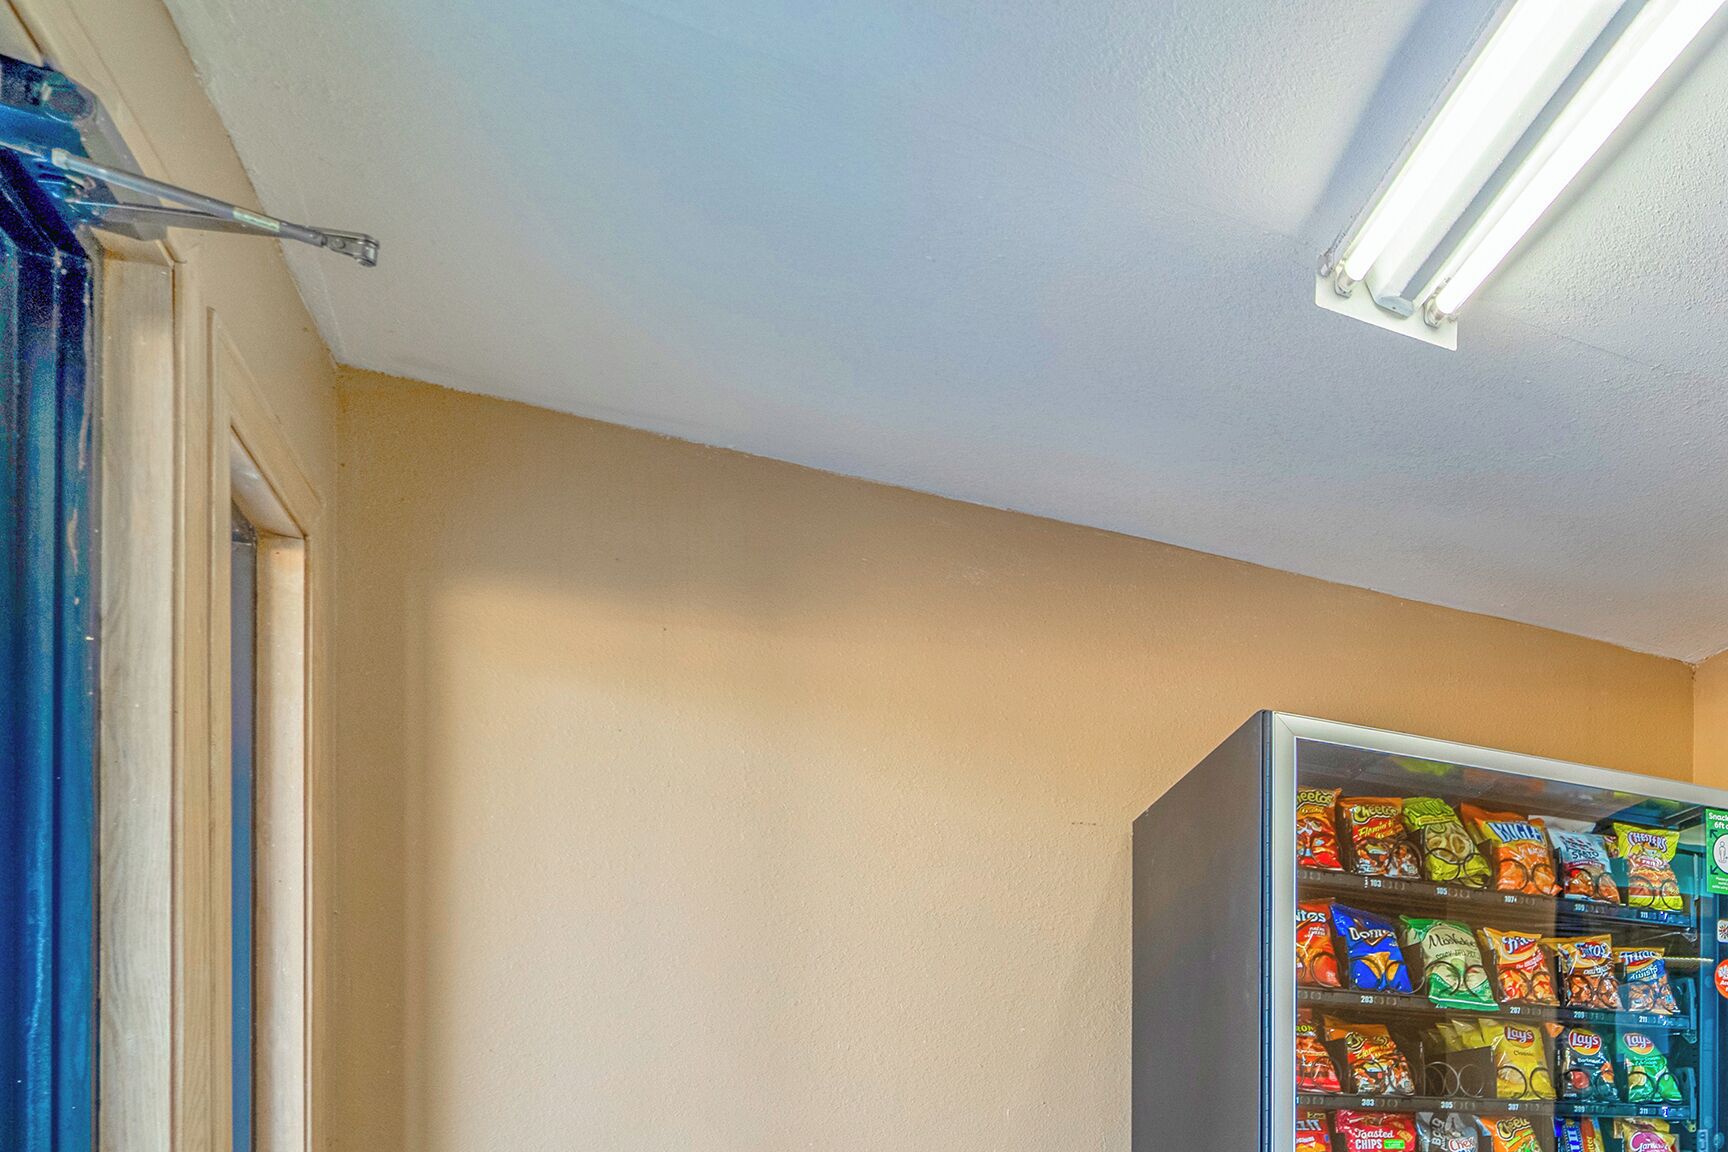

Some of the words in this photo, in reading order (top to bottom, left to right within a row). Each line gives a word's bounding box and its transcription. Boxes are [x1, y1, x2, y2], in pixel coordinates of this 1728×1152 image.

[1708, 812, 1728, 823] Snack
[1714, 821, 1725, 830] 6ft
[1507, 1028, 1533, 1043] Lay's
[1572, 1032, 1600, 1049] Lay's
[1354, 1127, 1395, 1139] Toasted
[1355, 1138, 1383, 1150] CHIPS
